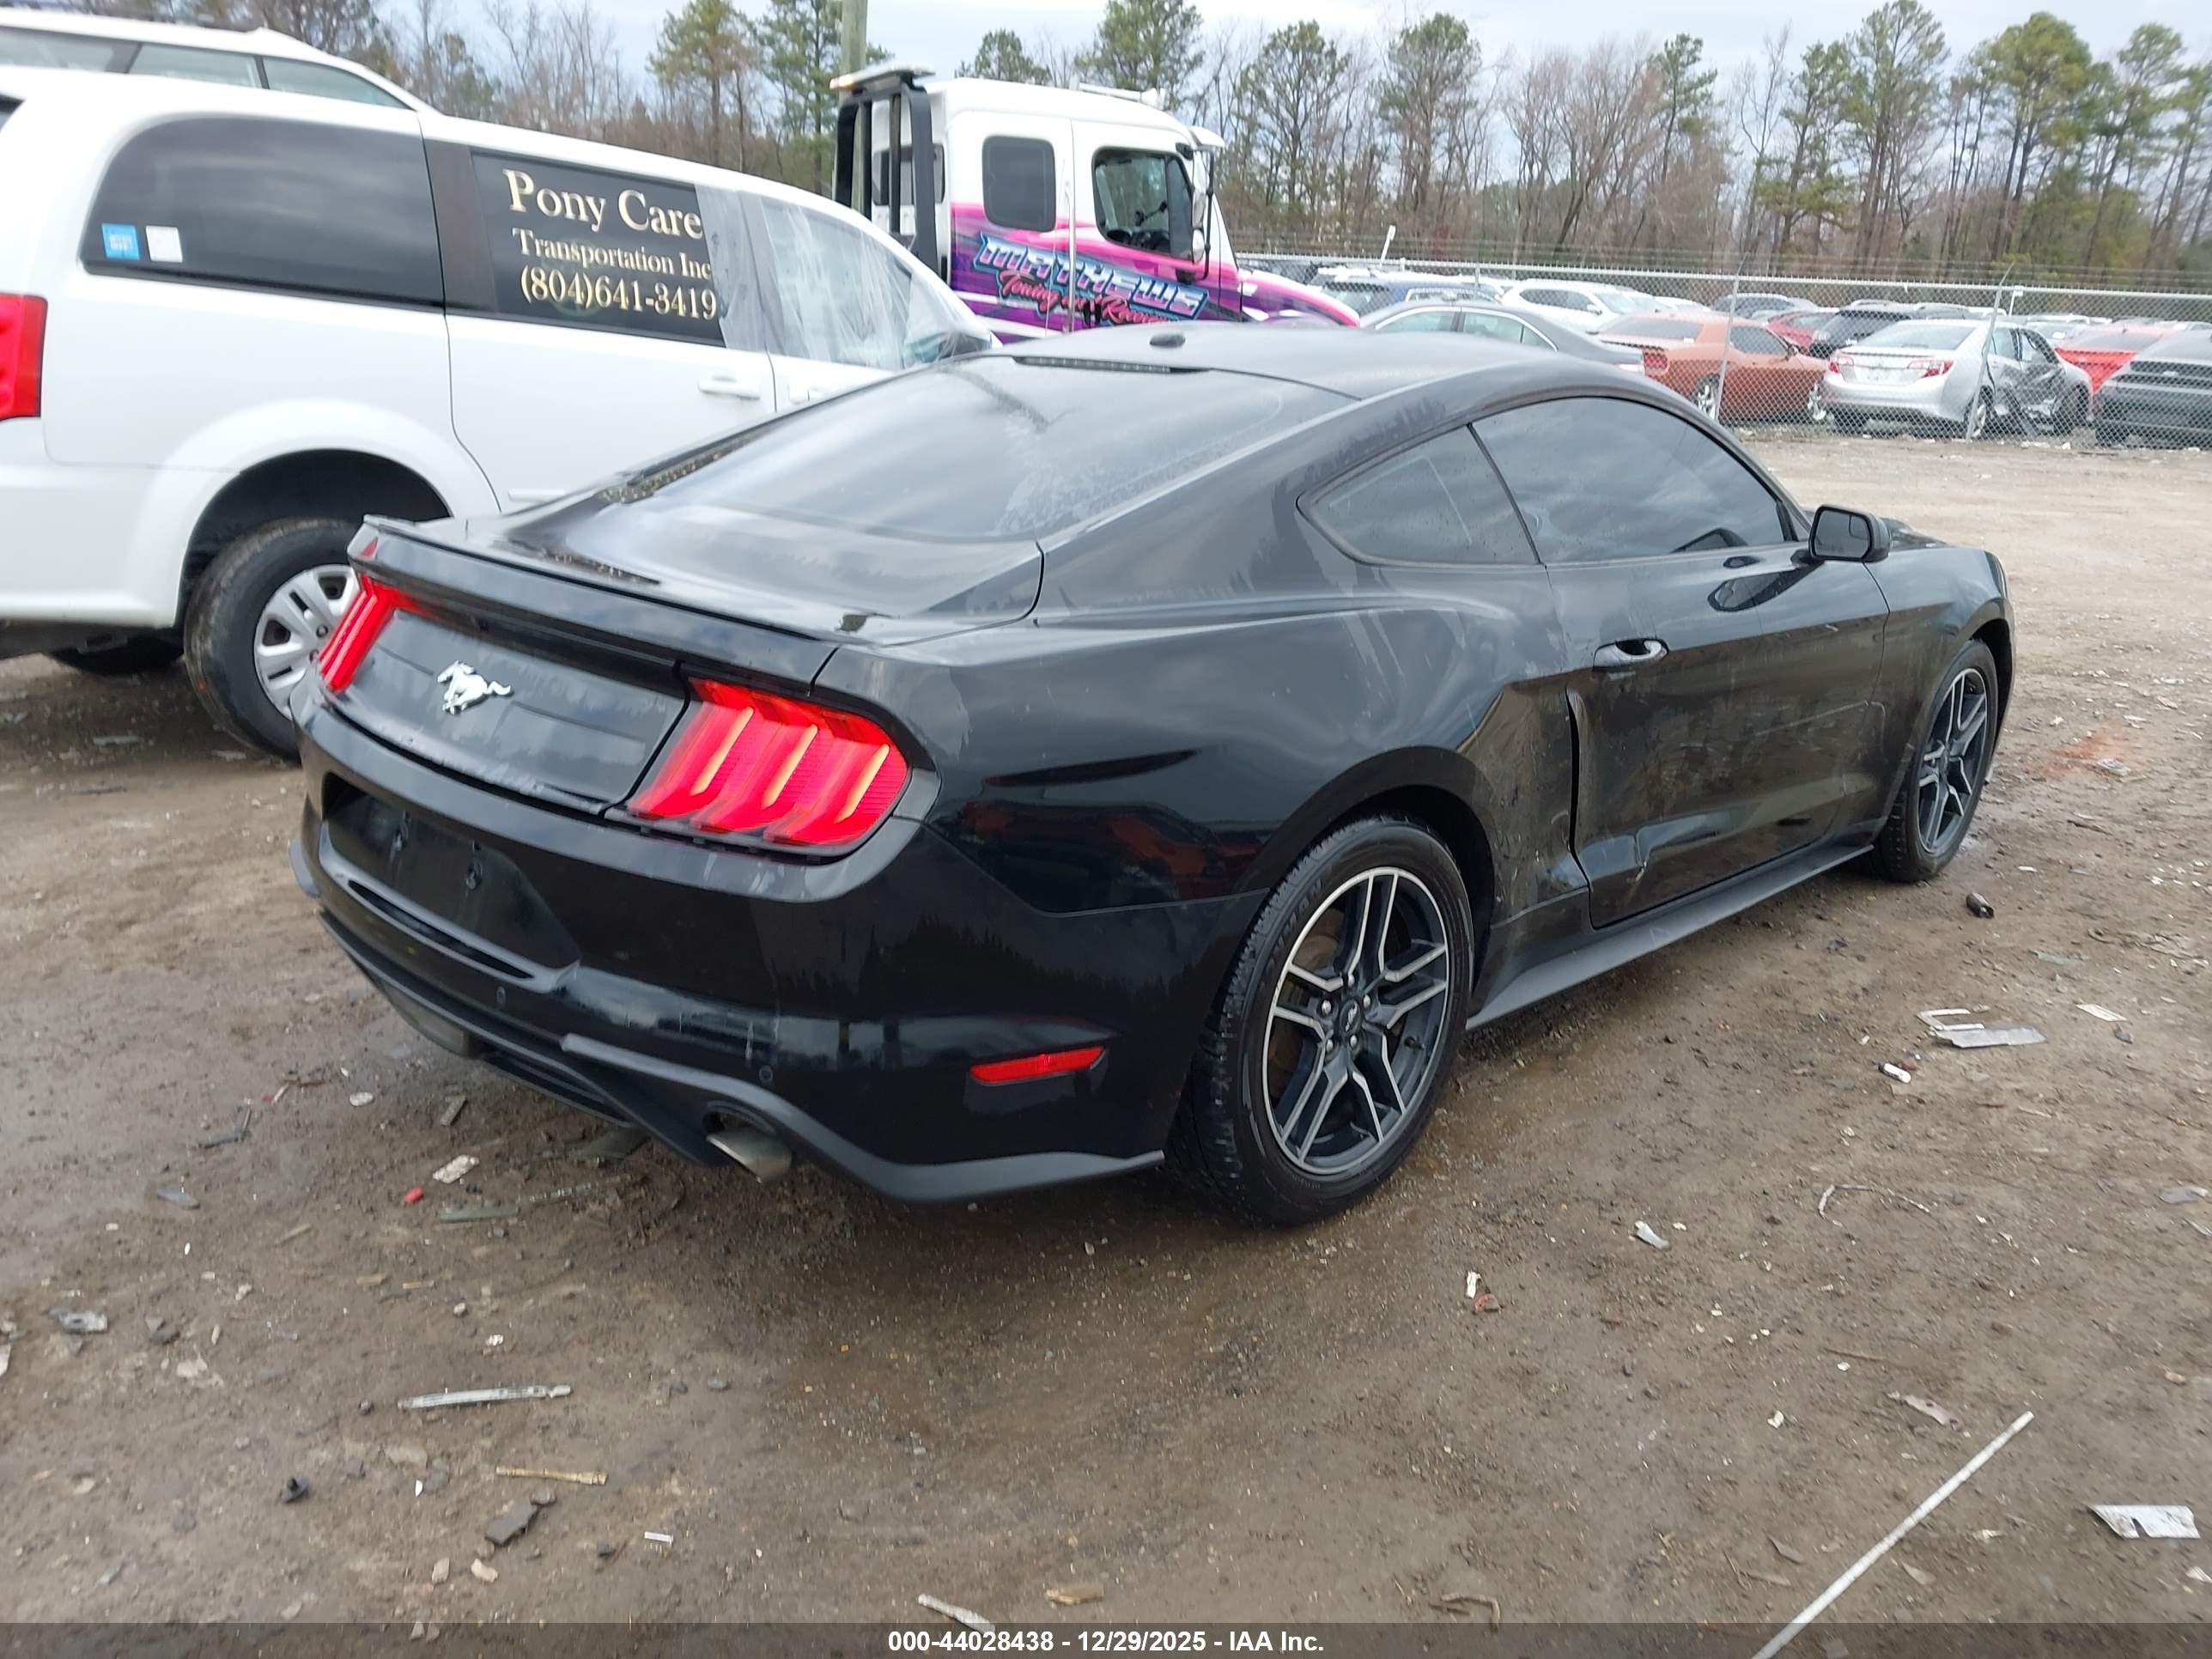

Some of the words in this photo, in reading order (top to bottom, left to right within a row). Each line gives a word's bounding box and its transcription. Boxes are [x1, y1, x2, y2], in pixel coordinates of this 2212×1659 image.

[502, 168, 606, 233] Pony
[618, 189, 702, 240] Care
[512, 227, 675, 276] Transportation
[679, 252, 712, 279] Inc
[520, 265, 717, 320] (804)641-3419
[999, 270, 1060, 313] Towing
